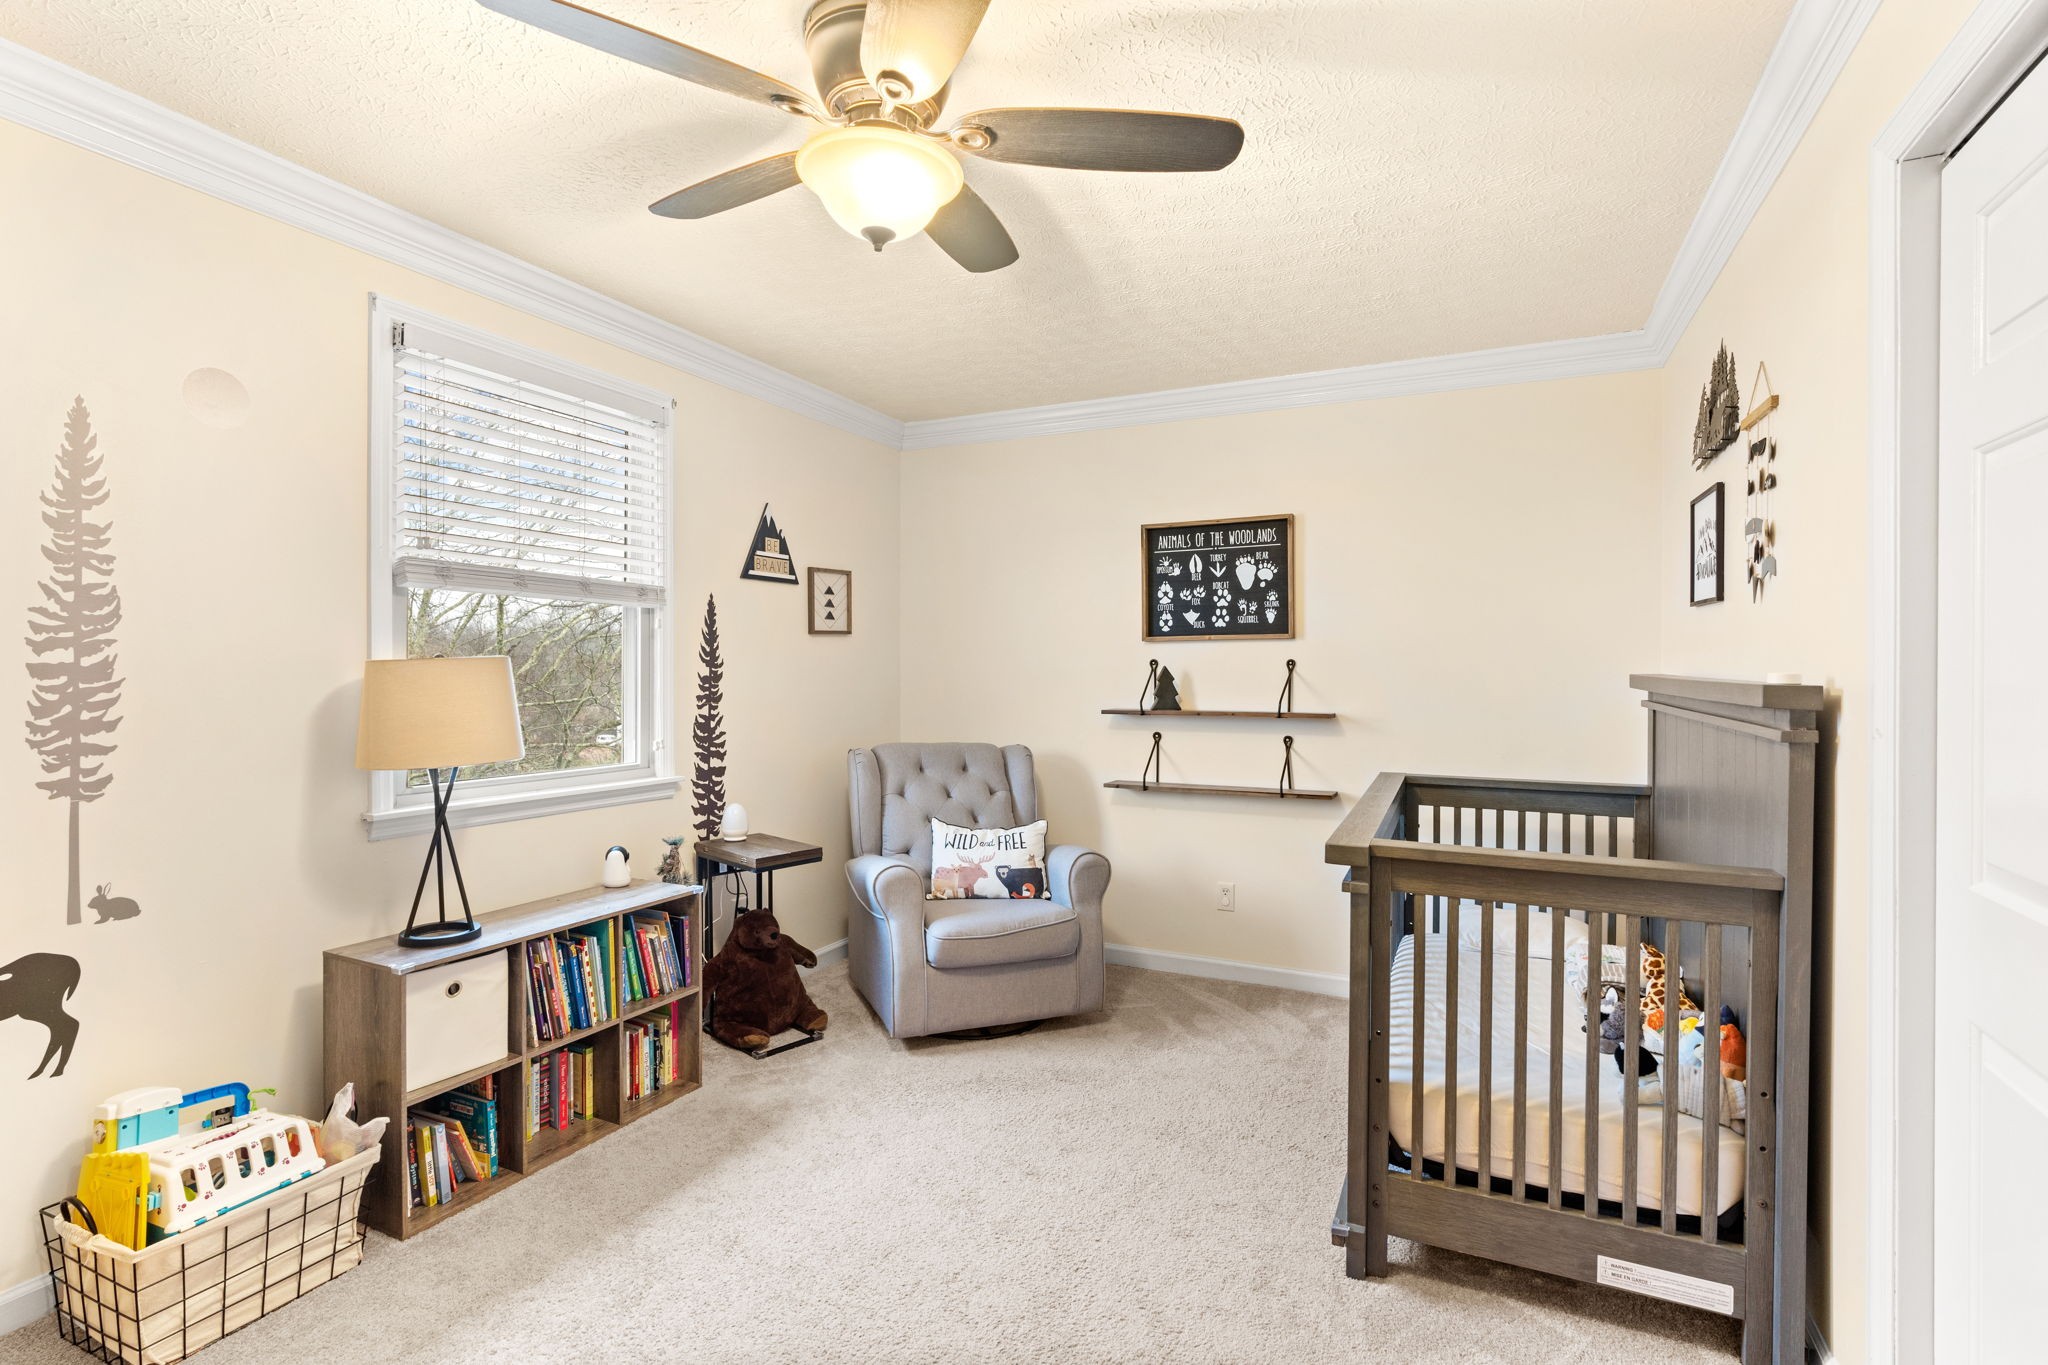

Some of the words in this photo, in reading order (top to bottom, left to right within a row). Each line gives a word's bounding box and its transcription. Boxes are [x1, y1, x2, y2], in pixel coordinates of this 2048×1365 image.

[1158, 533, 1191, 550] ANIMALS
[1195, 532, 1205, 547] OF
[1210, 531, 1224, 546] THE
[1229, 528, 1277, 545] WOODLANDS
[766, 539, 778, 553] BE
[1210, 553, 1227, 562] TURKEY
[1255, 551, 1269, 560] BEAR
[755, 558, 788, 574] BRAVE
[1212, 581, 1229, 590] BOBCAT
[1191, 597, 1201, 606] FOX
[1157, 603, 1174, 612] COYOTE
[1193, 620, 1206, 629] DUCK
[944, 832, 979, 850] WILD
[979, 839, 996, 847] and
[997, 831, 1027, 851] FREE
[1610, 1263, 1634, 1273] WARNING
